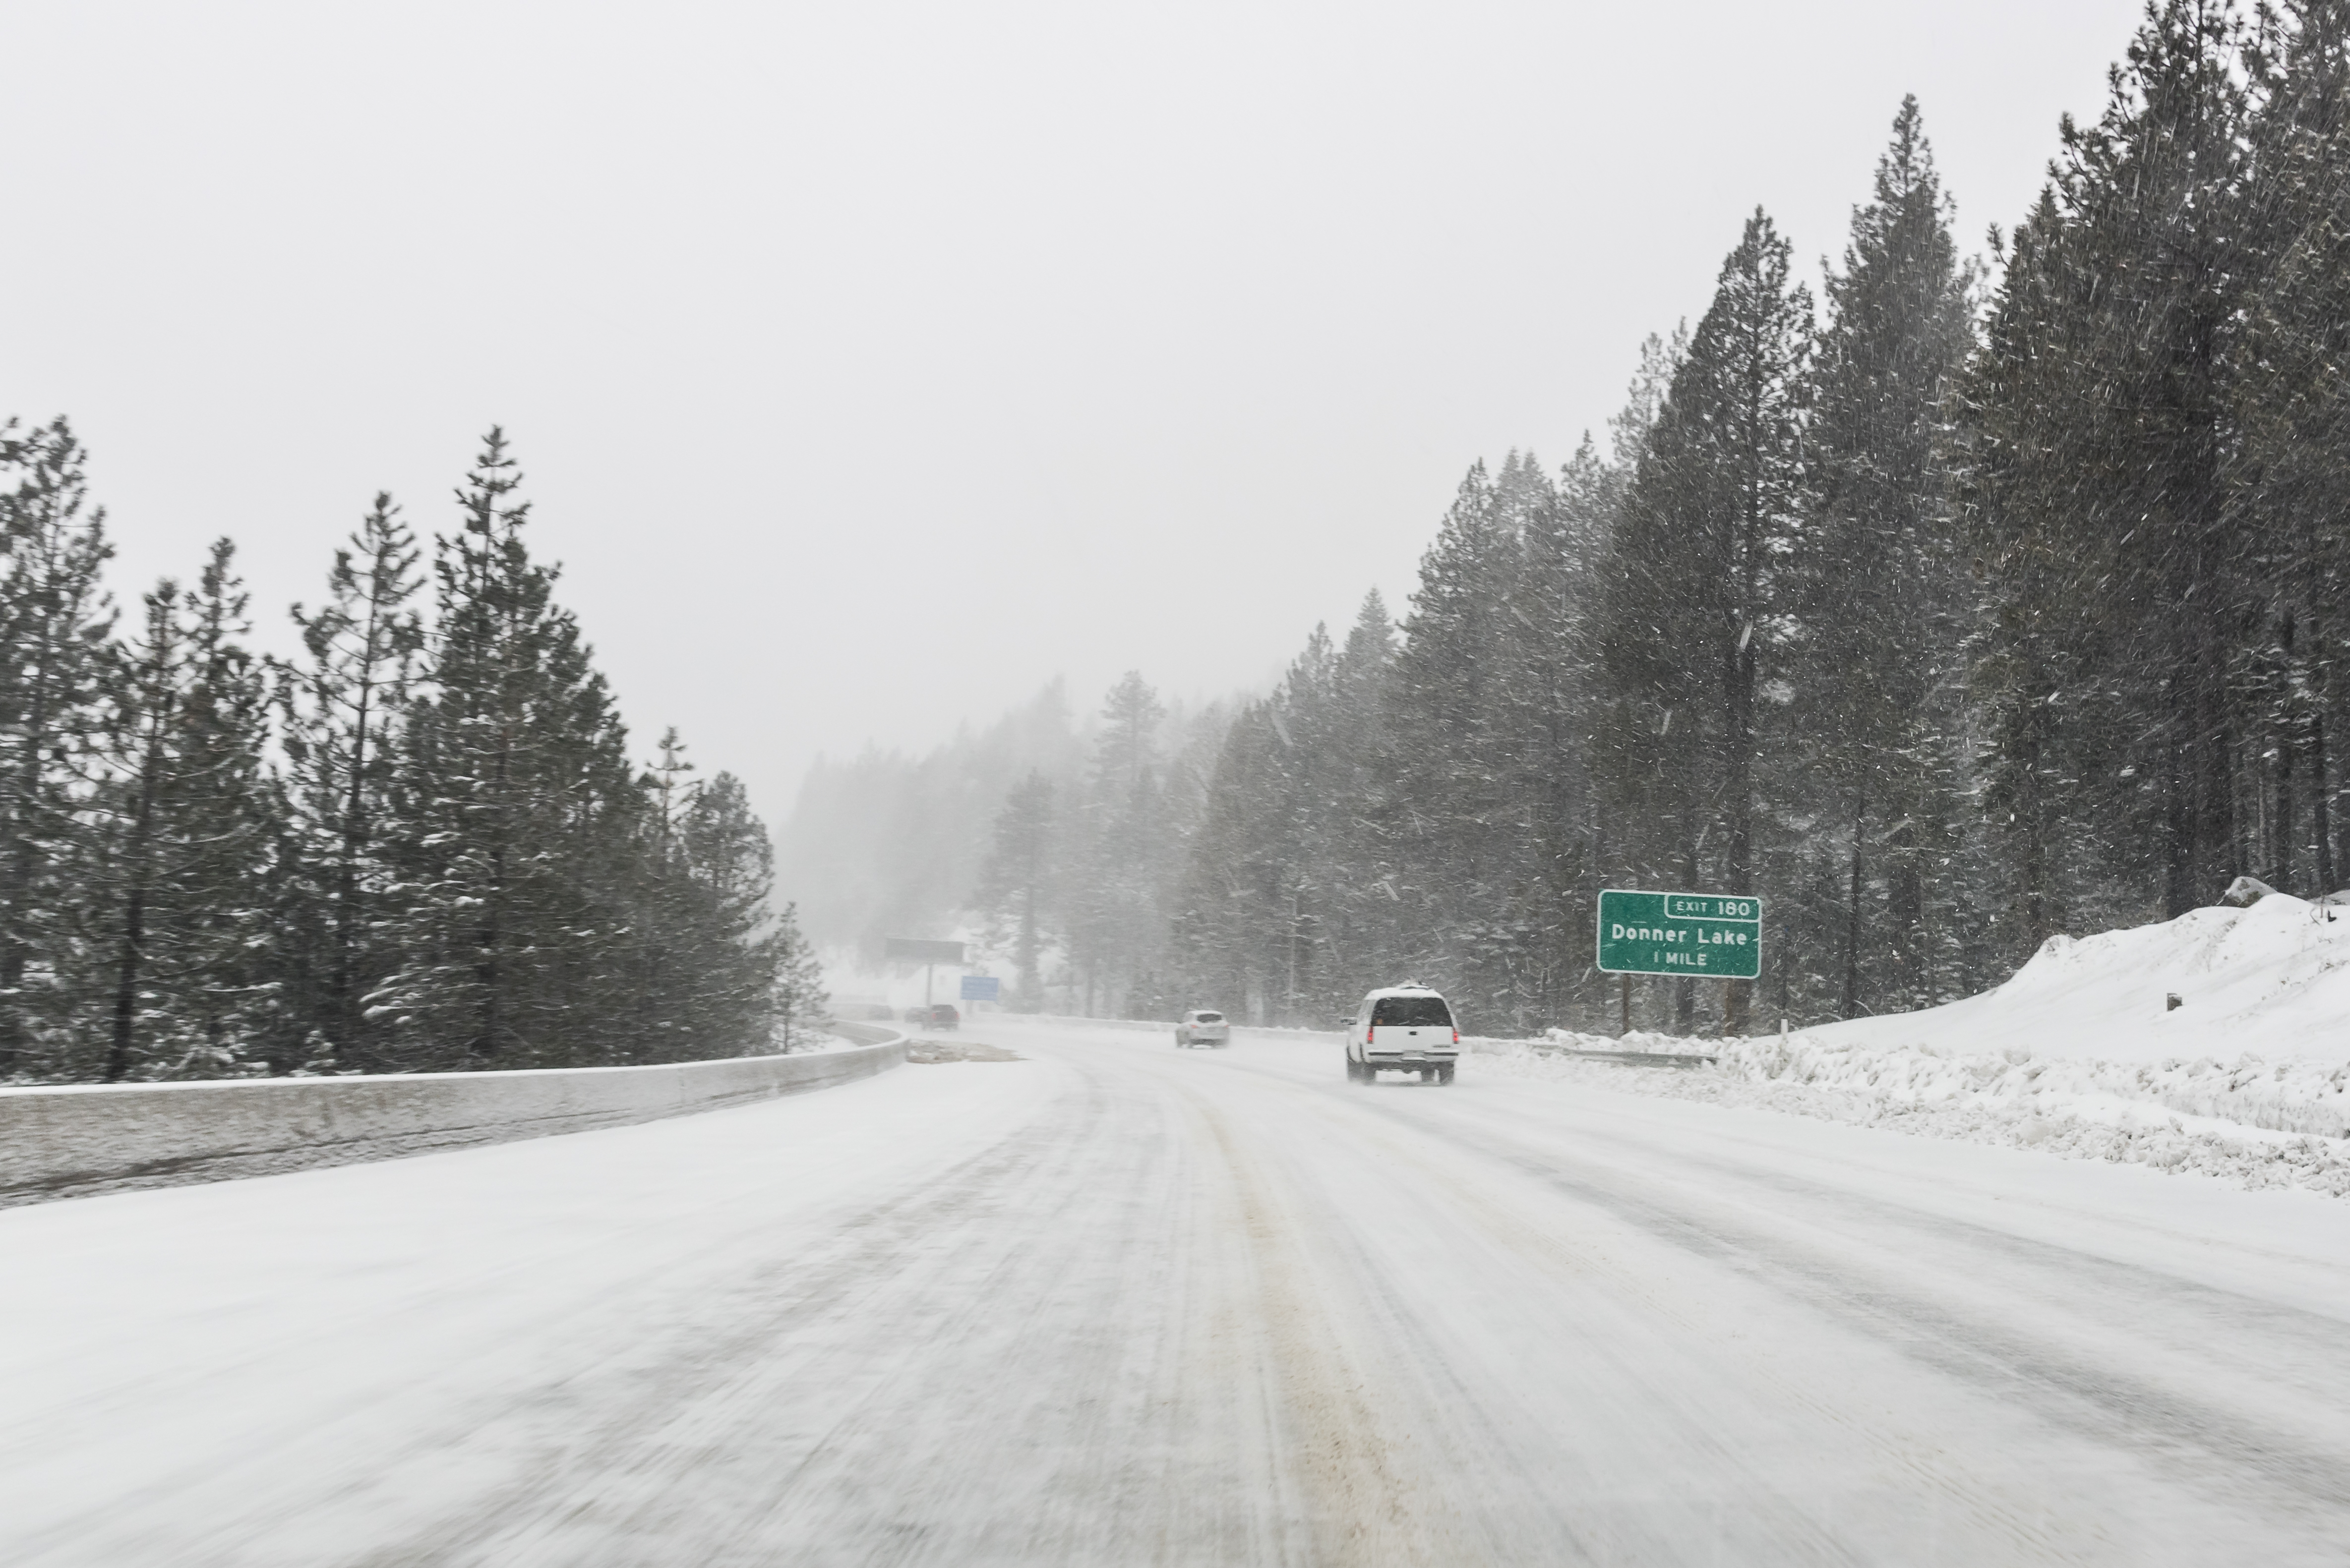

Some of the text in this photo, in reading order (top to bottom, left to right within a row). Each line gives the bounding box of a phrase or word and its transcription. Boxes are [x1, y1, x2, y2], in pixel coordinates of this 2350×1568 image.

[1676, 901, 1750, 916] EXIT 180
[1612, 924, 1747, 945] Donner Lake
[1653, 951, 1707, 966] 1 MILE
